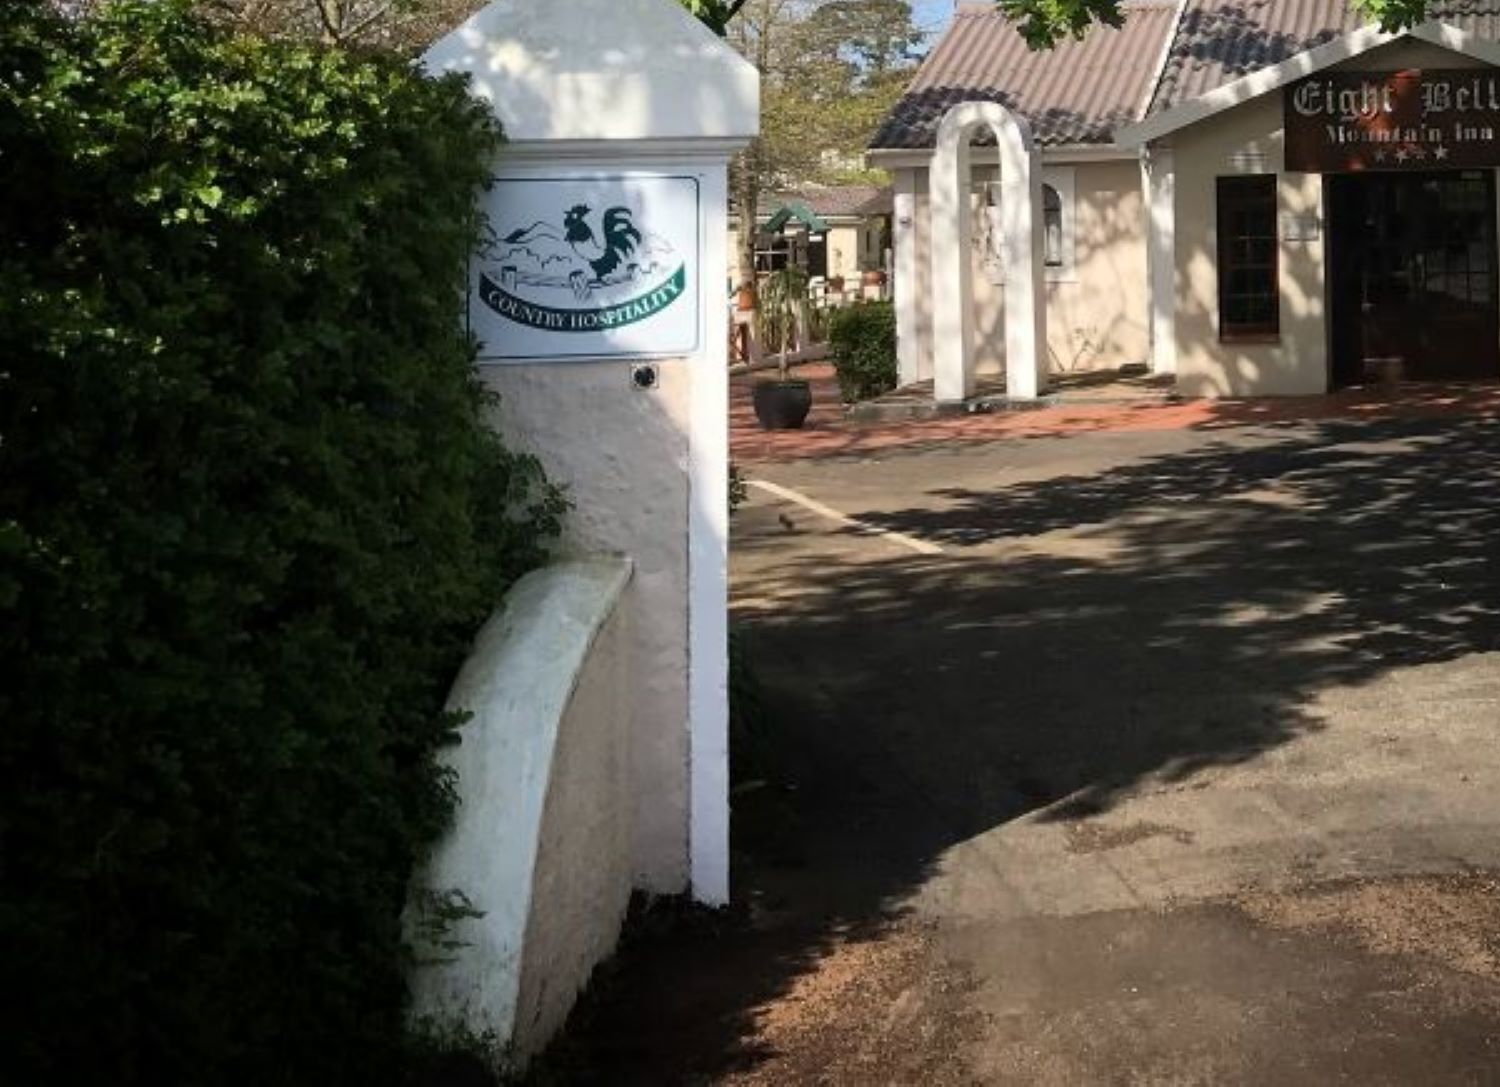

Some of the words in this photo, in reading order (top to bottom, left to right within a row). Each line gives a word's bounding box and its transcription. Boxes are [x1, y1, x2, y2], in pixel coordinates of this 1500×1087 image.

[1293, 80, 1394, 122] Eight
[1326, 123, 1441, 143] Mountain
[1455, 122, 1493, 141] Inn
[488, 289, 566, 328] COUNTRY
[570, 278, 679, 329] HOSPITALITY
